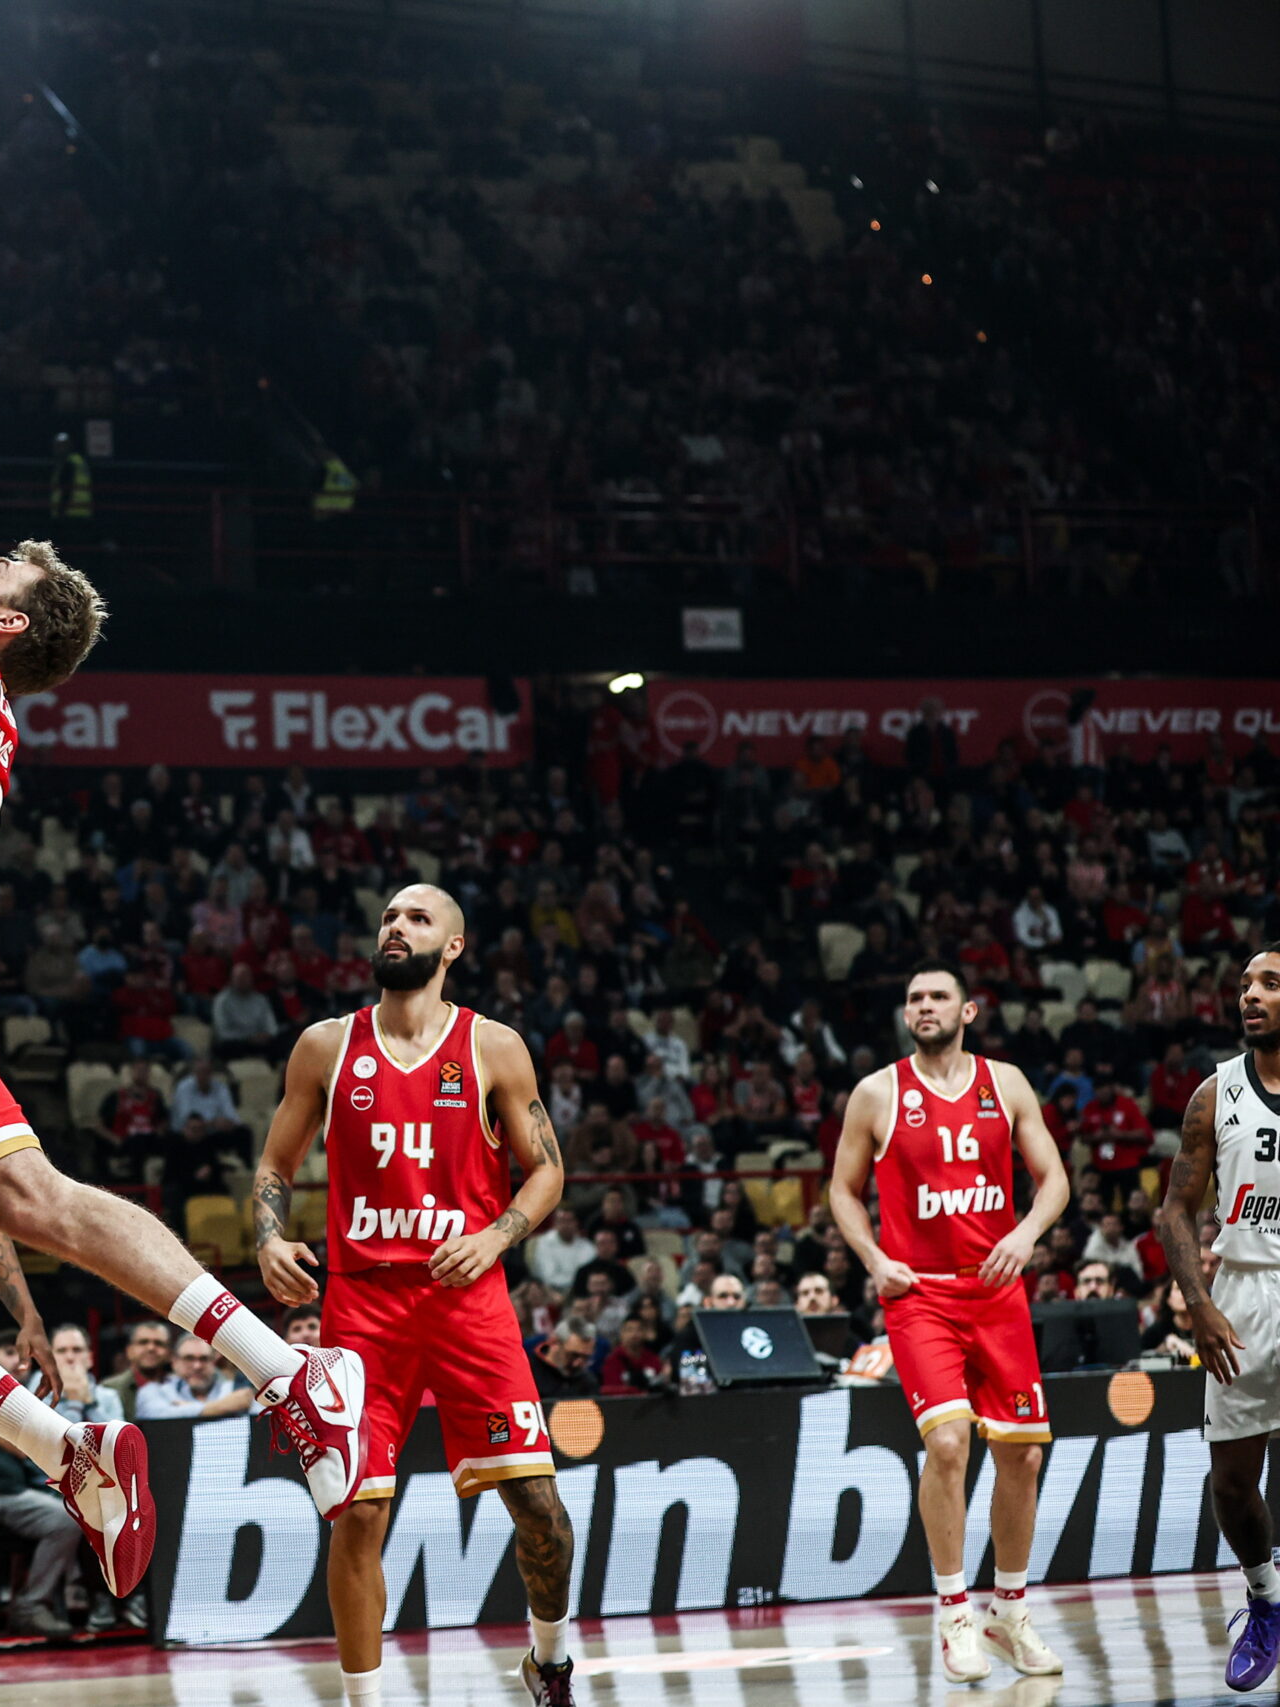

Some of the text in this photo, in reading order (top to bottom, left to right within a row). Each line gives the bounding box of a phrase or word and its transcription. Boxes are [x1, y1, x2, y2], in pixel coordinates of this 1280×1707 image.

[273, 691, 519, 750] FlexCar
[723, 708, 979, 743] NEVER QIT
[370, 1122, 435, 1169] 94
[937, 1123, 980, 1163] 16
[1255, 1128, 1280, 1162] 3
[346, 1193, 466, 1241] bwin
[918, 1173, 1006, 1220] bwin
